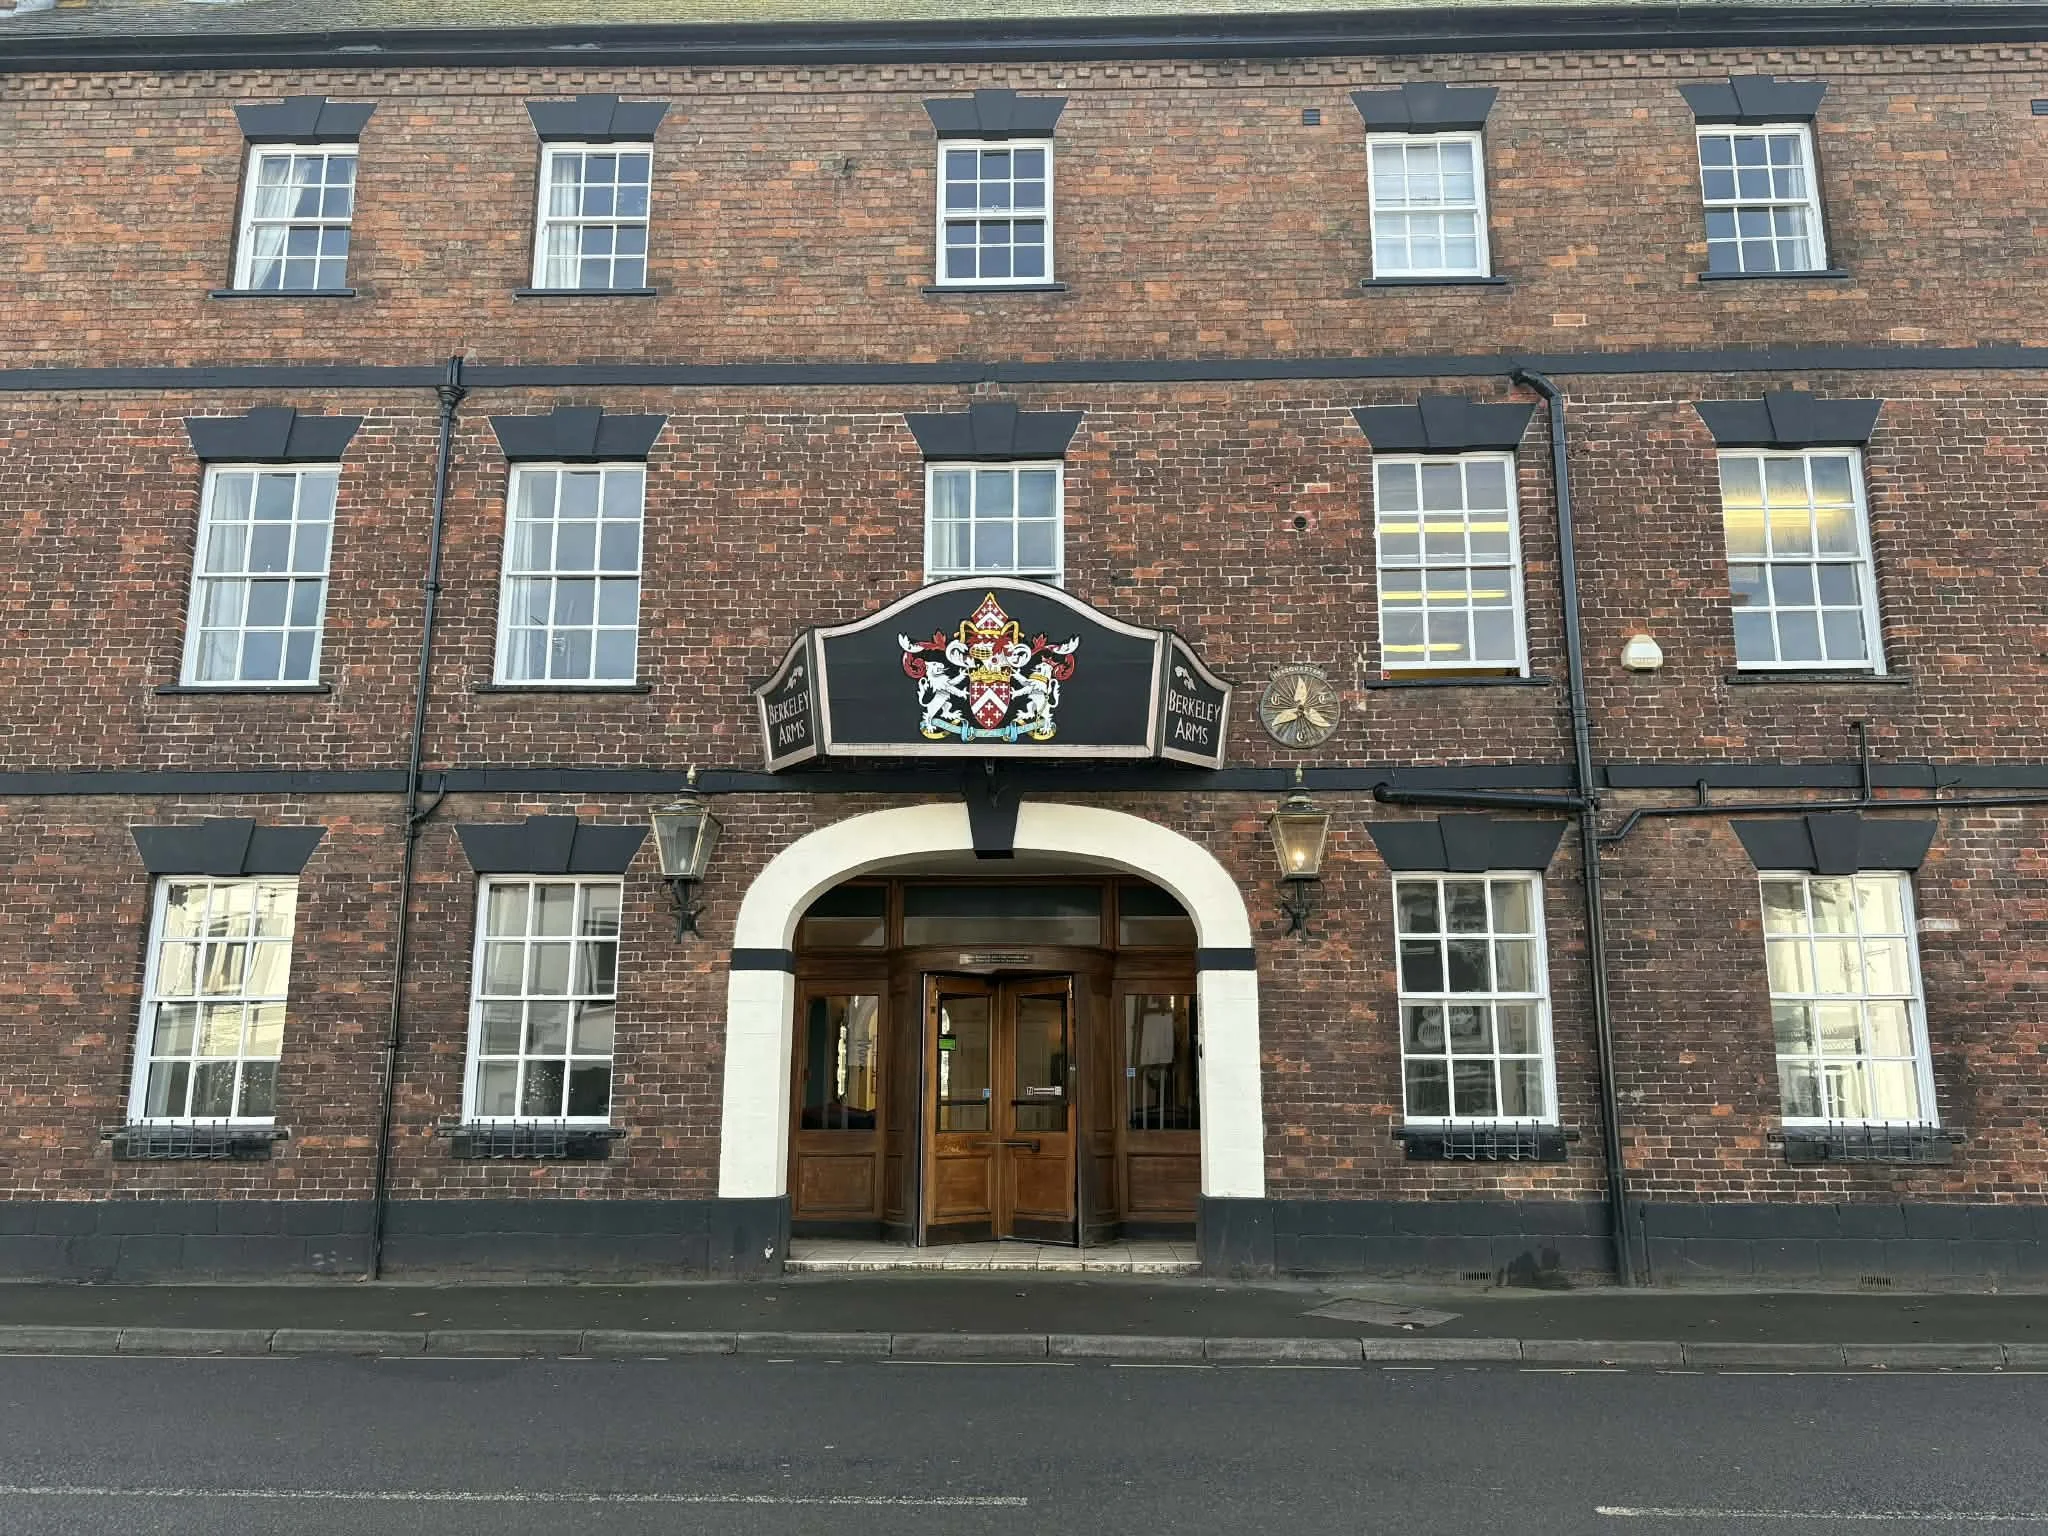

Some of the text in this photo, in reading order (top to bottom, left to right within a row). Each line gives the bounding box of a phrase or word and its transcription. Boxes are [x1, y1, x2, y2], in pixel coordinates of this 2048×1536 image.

[768, 689, 809, 726] BERKELEY
[1168, 688, 1221, 723] BERKELEY
[778, 718, 806, 747] ARMS
[1174, 716, 1209, 745] ARMS
